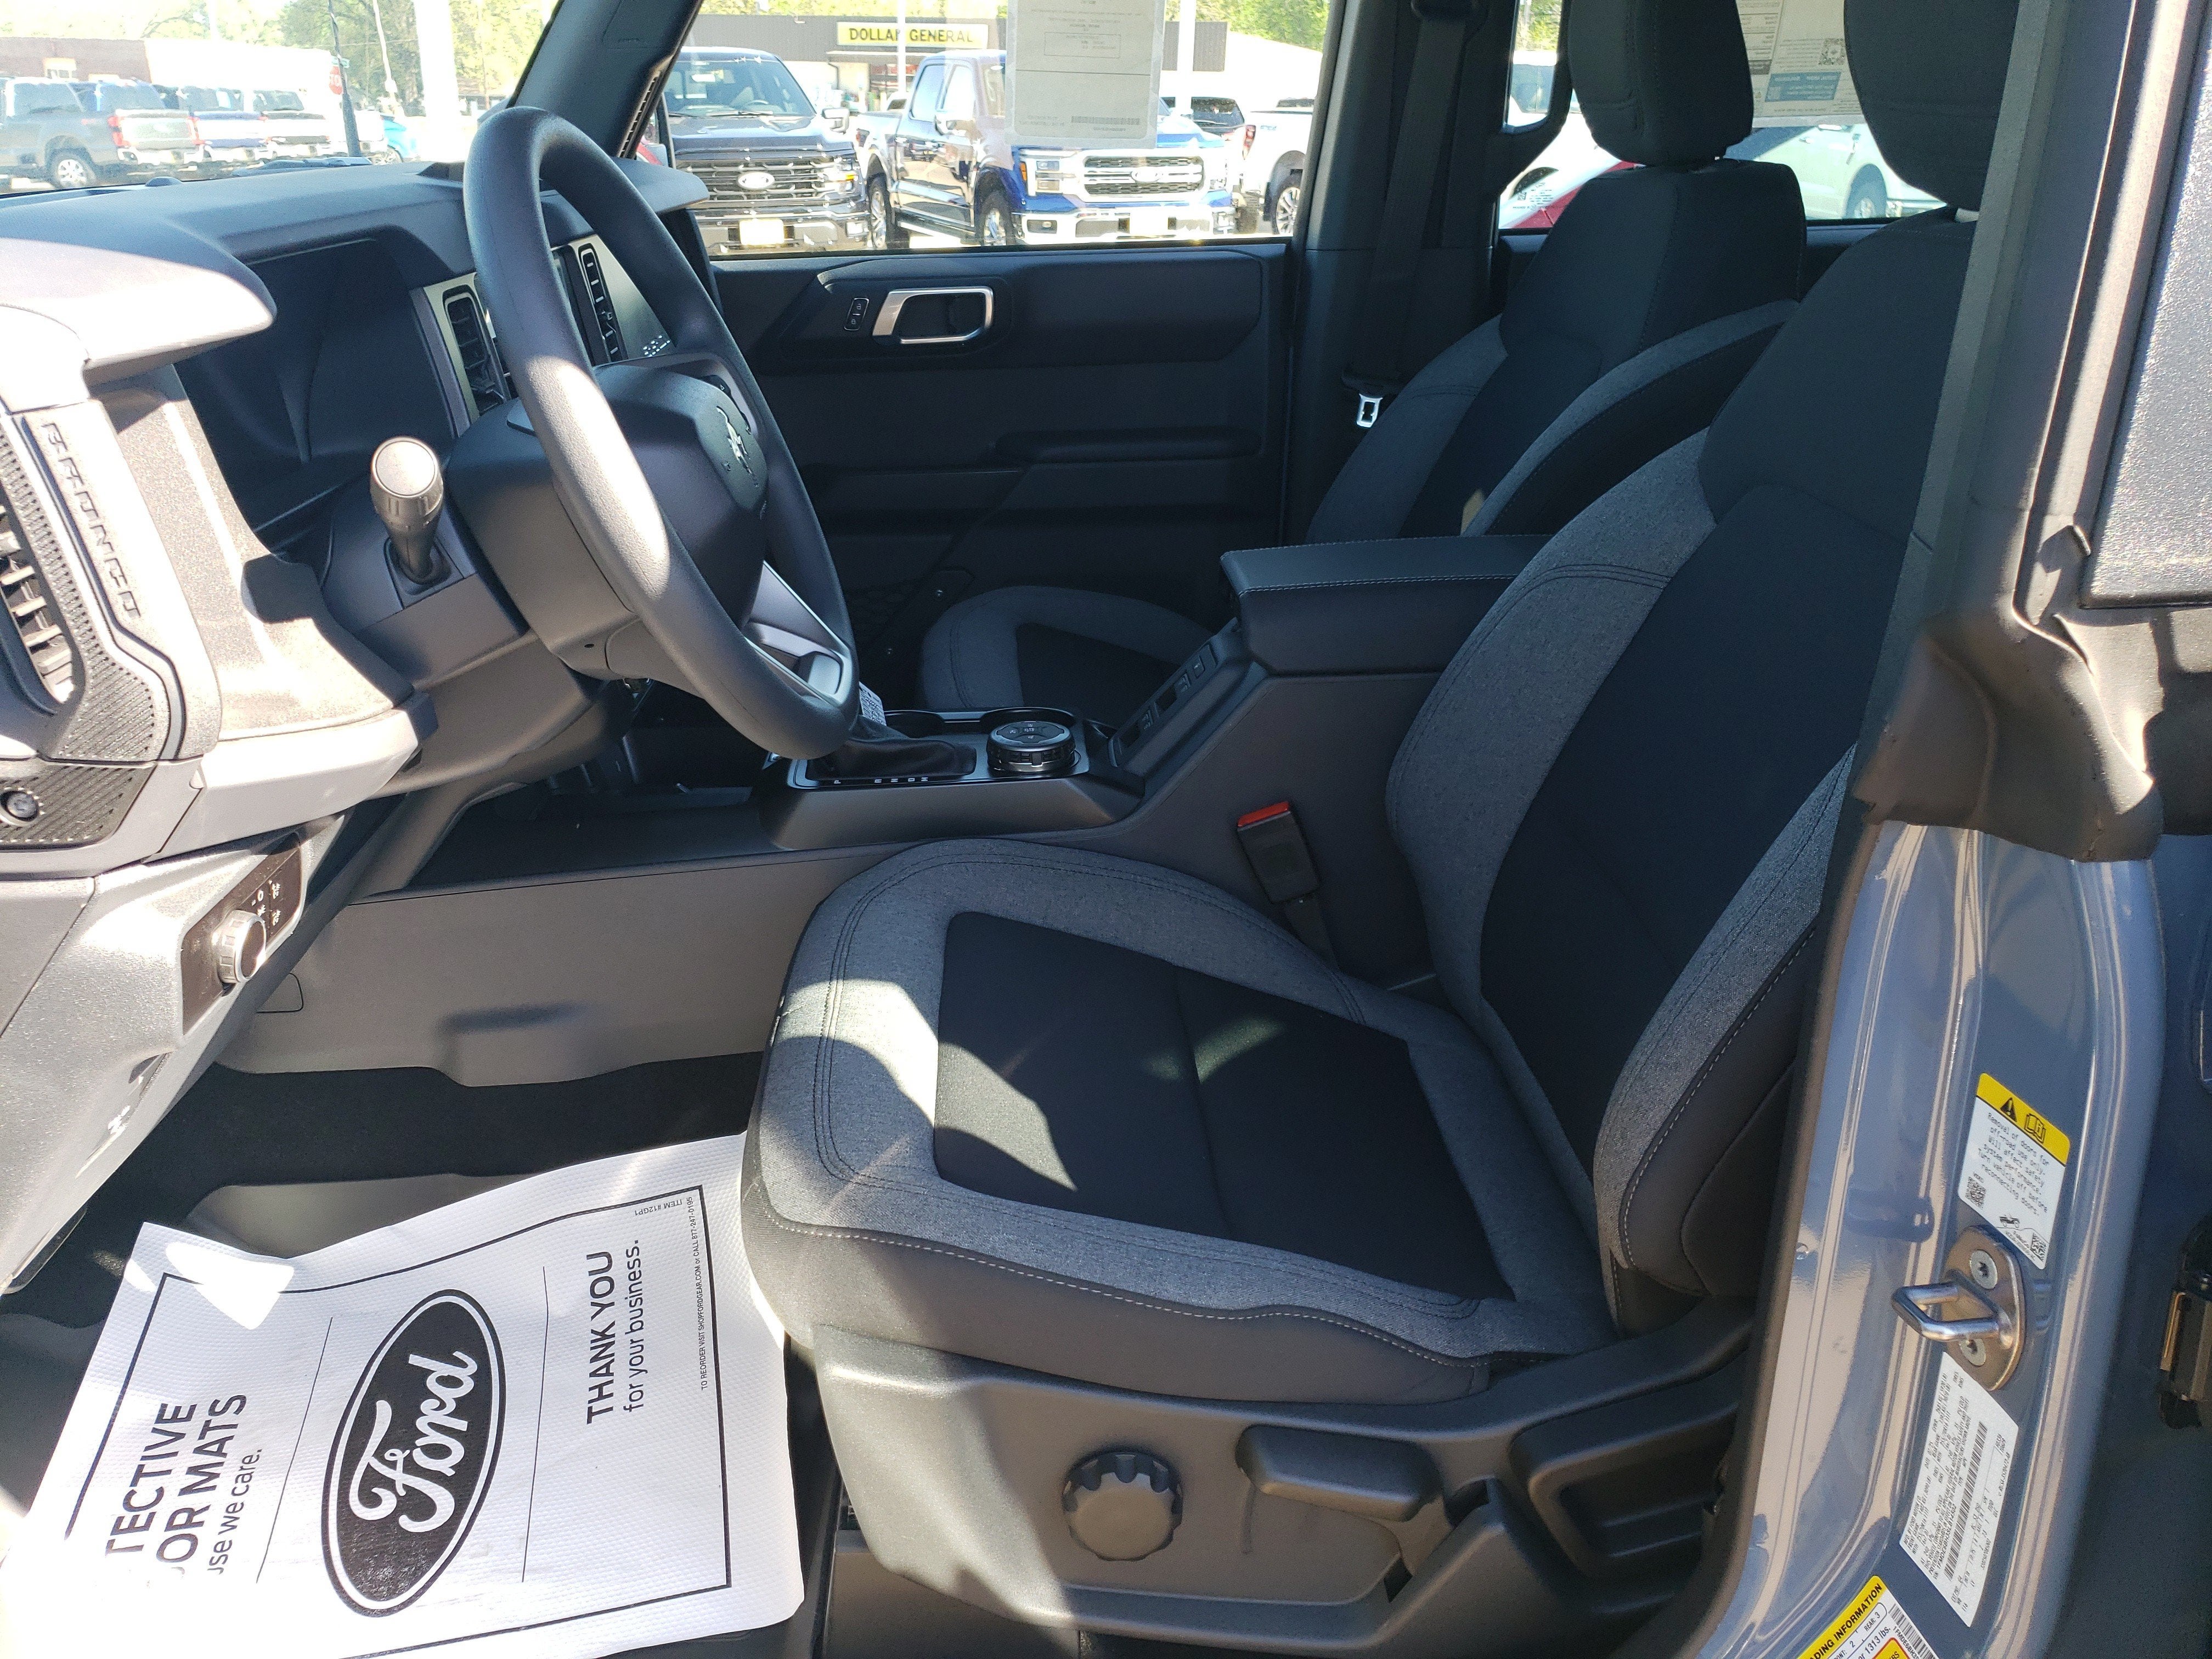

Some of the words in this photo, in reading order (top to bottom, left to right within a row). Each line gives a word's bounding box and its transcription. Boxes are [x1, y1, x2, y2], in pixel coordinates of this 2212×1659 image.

[909, 29, 973, 42] GENERAL
[41, 423, 141, 618] BRONCO
[1988, 1112, 2010, 1135] Removal
[2011, 1131, 2018, 1141] of
[2020, 1138, 2037, 1158] doors
[2039, 1154, 2050, 1168] for
[1988, 1134, 2001, 1150] Will
[2003, 1147, 2023, 1168] affect
[2023, 1164, 2045, 1189] safety
[1990, 1125, 2016, 1151] off-road
[2017, 1148, 2028, 1161] use
[2029, 1158, 2046, 1178] only.
[1977, 1147, 1991, 1164] Turn
[1993, 1161, 2015, 1184] vehicle
[2016, 1180, 2026, 1193] off
[2028, 1190, 2049, 1214] before
[1980, 1163, 2019, 1201] reconnecting
[2021, 1196, 2040, 1217] doors.
[1983, 1143, 2002, 1164] system
[2004, 1159, 2042, 1196] performance.
[634, 1205, 662, 1216] #12GP1
[663, 1199, 682, 1209] ITEM
[686, 1197, 697, 1239] 877-247-0195
[586, 1251, 615, 1321] YOU
[624, 1239, 645, 1335] business.
[694, 1266, 704, 1331] SHOPFORDGEAR.COM
[586, 1321, 616, 1425] THANK
[629, 1339, 648, 1379] your
[701, 1380, 708, 1391] TO
[623, 1384, 644, 1413] for
[178, 1395, 247, 1497] MATS
[349, 1351, 478, 1532] Ford
[231, 1448, 263, 1497] care.
[156, 1504, 211, 1575] OR
[218, 1500, 245, 1535] we
[1810, 1639, 1835, 1659] DING
[1833, 1583, 1883, 1641] INFORMATION
[1864, 1618, 1877, 1632] REAR:
[1865, 1635, 1881, 1654] 1313
[1878, 1627, 1891, 1640] lbs.
